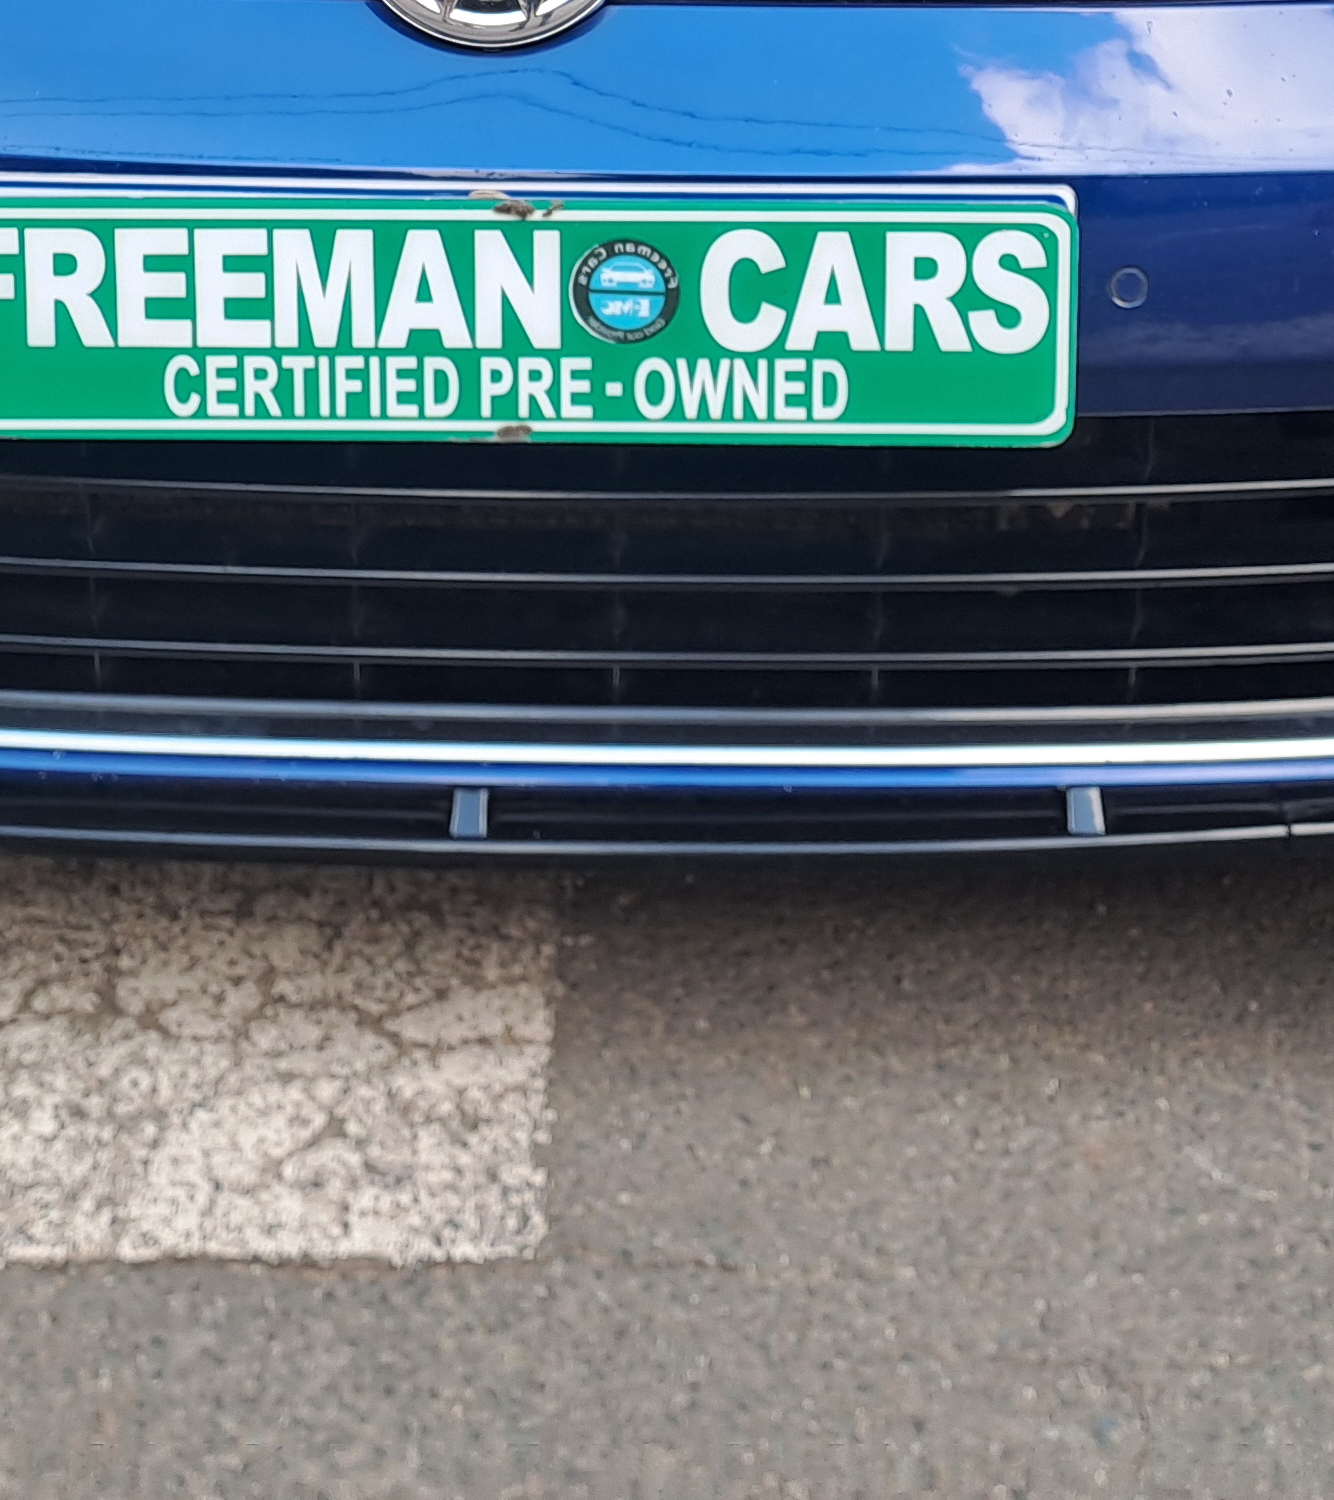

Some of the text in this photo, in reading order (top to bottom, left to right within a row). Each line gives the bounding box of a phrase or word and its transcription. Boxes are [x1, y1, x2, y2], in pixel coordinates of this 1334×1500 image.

[699, 229, 1051, 354] CARS
[162, 353, 460, 420] CERTIFIED
[479, 355, 593, 421] PRE
[633, 357, 850, 422] OWNED
